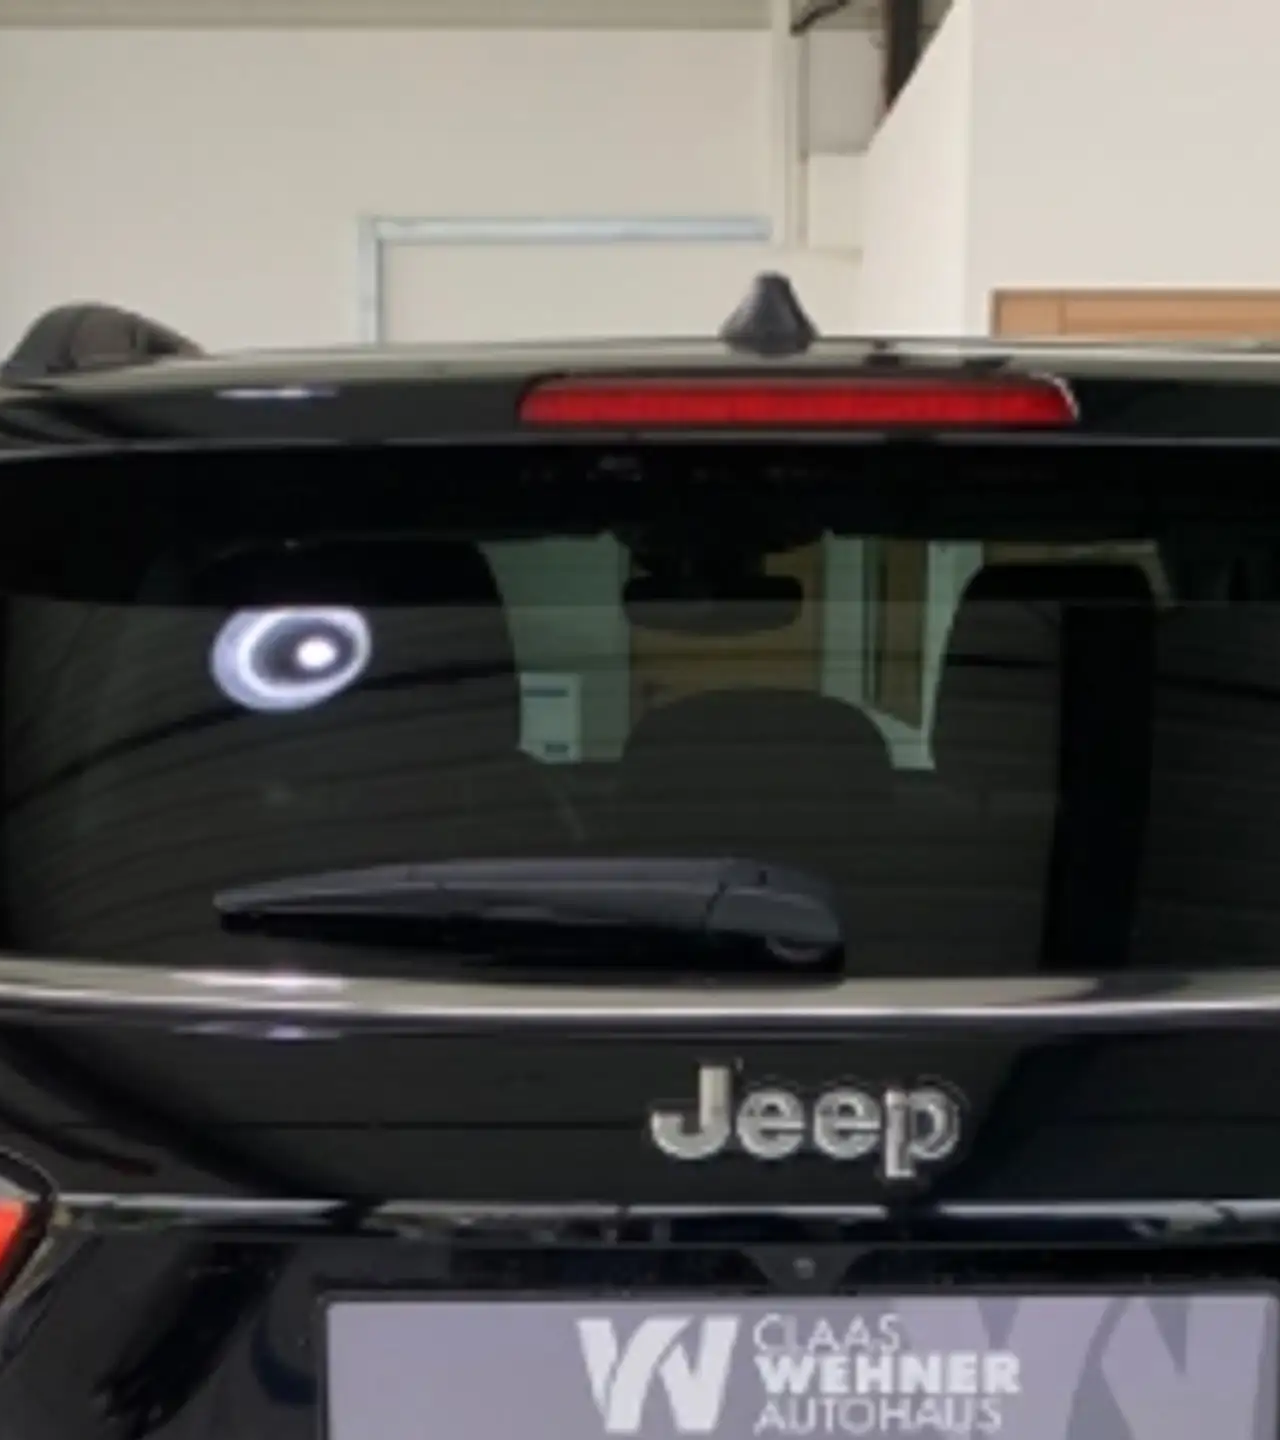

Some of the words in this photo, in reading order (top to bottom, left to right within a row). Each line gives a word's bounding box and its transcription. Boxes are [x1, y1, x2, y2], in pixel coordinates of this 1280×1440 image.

[651, 1064, 961, 1180] Jeep
[752, 1312, 902, 1354] CLAAS
[752, 1354, 1021, 1395] WEHNER
[752, 1396, 1004, 1434] AUTOHAUS
